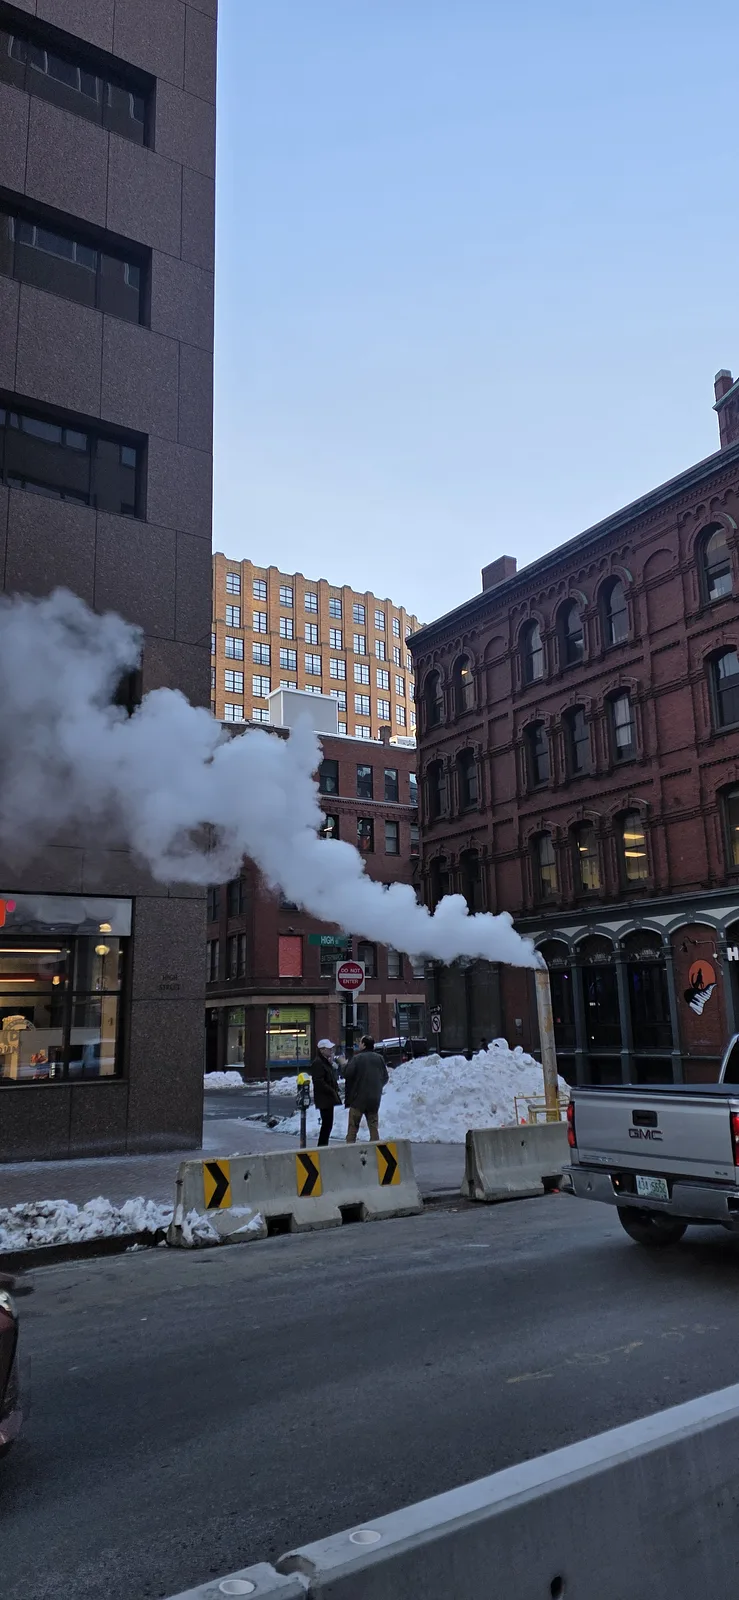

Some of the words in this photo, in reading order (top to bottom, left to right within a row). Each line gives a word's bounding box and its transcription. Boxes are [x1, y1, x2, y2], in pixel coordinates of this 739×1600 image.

[320, 936, 334, 944] HIGH
[726, 946, 738, 962] H
[628, 1128, 663, 1142] GMC
